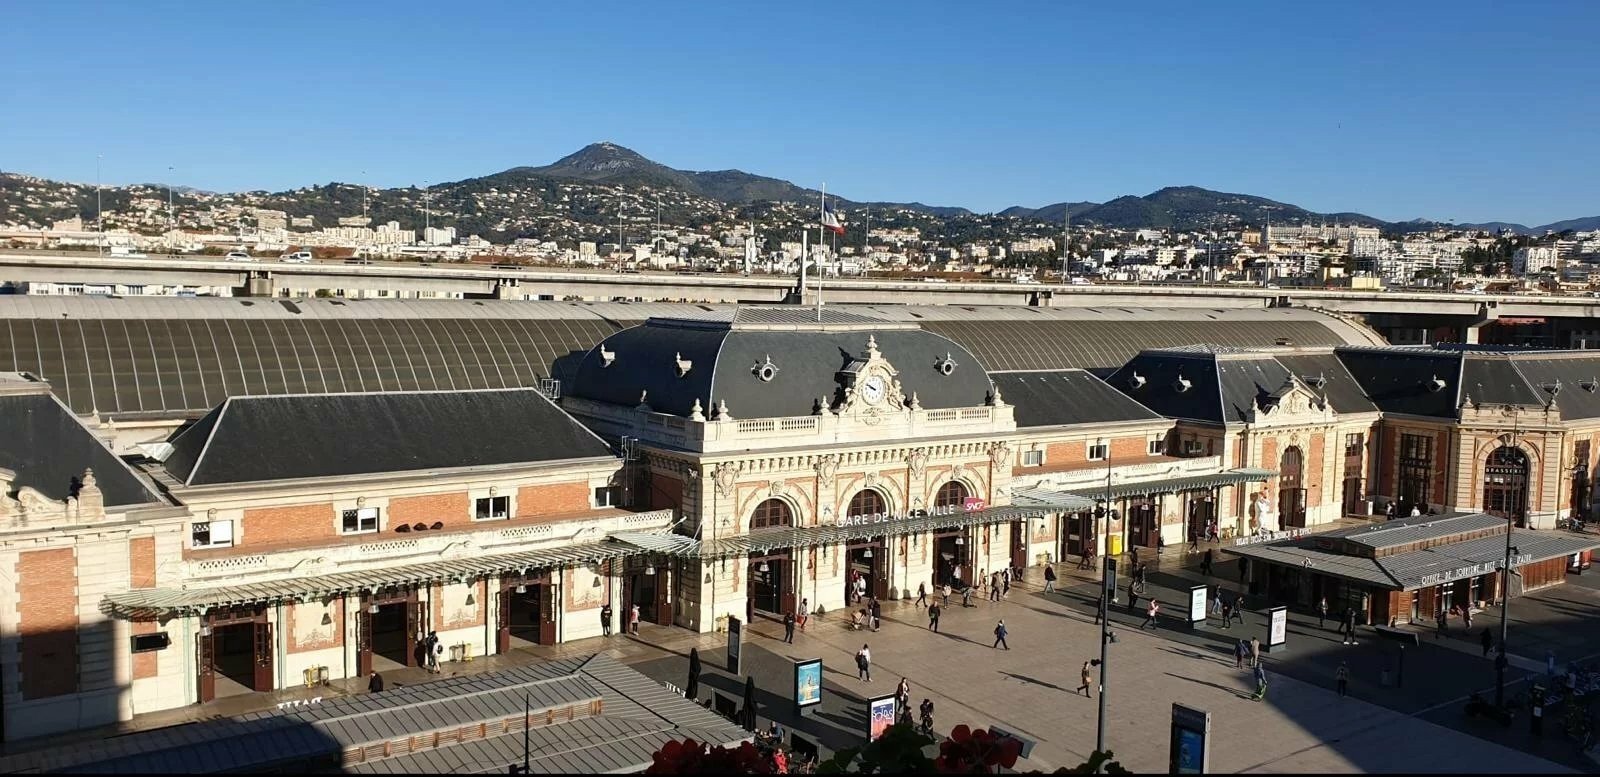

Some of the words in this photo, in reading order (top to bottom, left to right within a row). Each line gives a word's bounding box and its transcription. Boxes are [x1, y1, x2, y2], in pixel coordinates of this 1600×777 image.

[836, 513, 869, 528] GARE
[874, 511, 889, 523] DE
[894, 508, 921, 521] NICE
[926, 503, 955, 517] VILLE
[965, 500, 985, 511] SNCF
[1421, 572, 1440, 585] OFFICE
[1484, 560, 1496, 572] NICE
